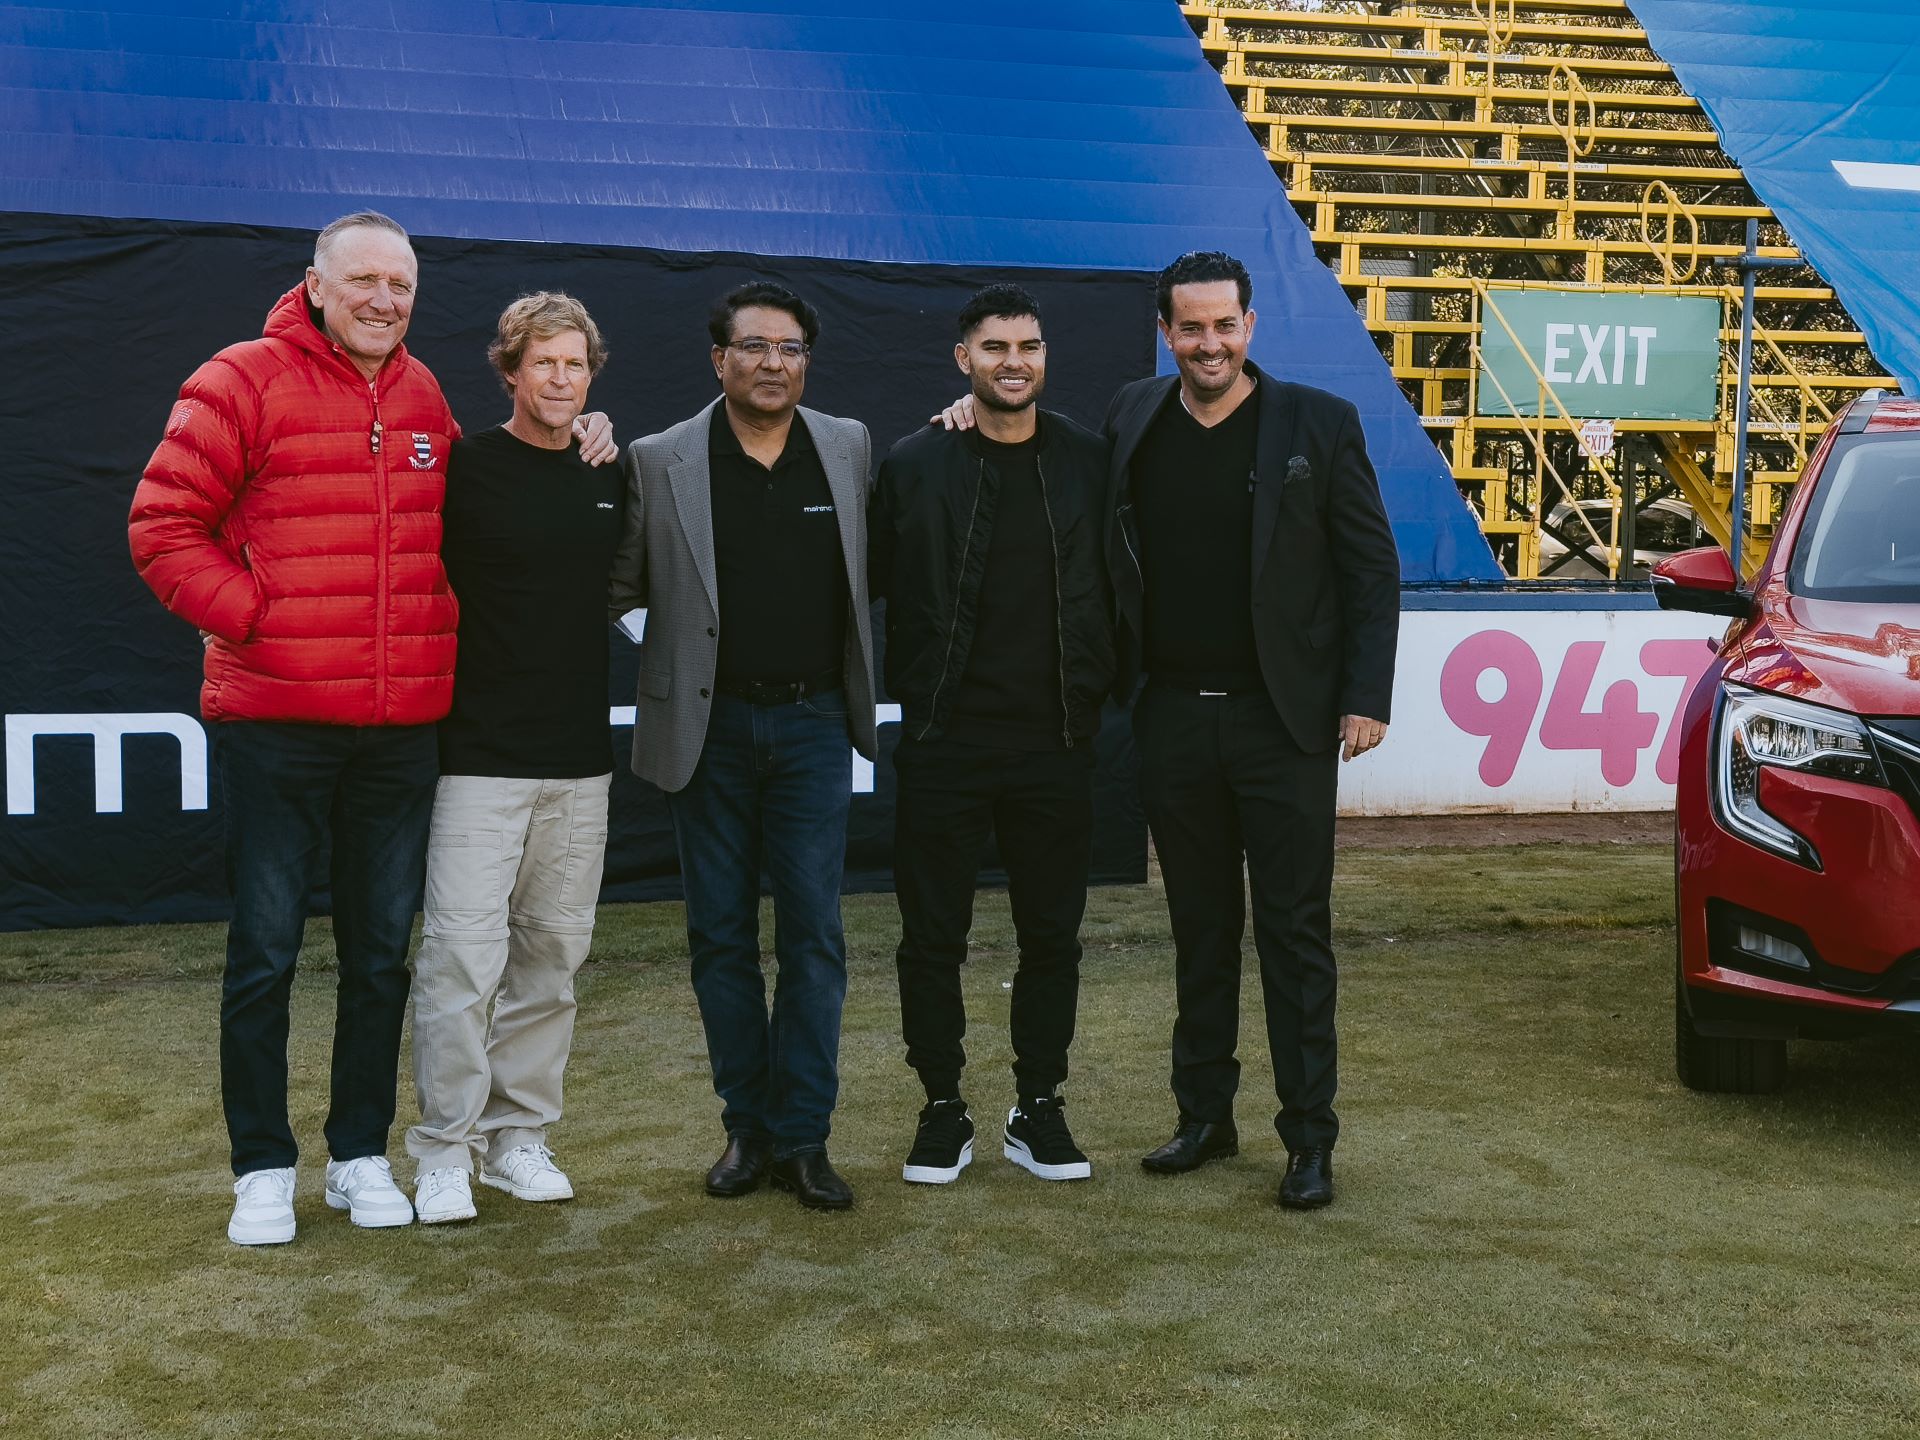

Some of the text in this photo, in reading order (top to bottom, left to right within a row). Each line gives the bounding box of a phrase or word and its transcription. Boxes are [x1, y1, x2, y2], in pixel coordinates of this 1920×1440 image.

[1544, 323, 1657, 385] EXIT
[1585, 435, 1608, 450] EXIT
[1440, 629, 1722, 787] 947
